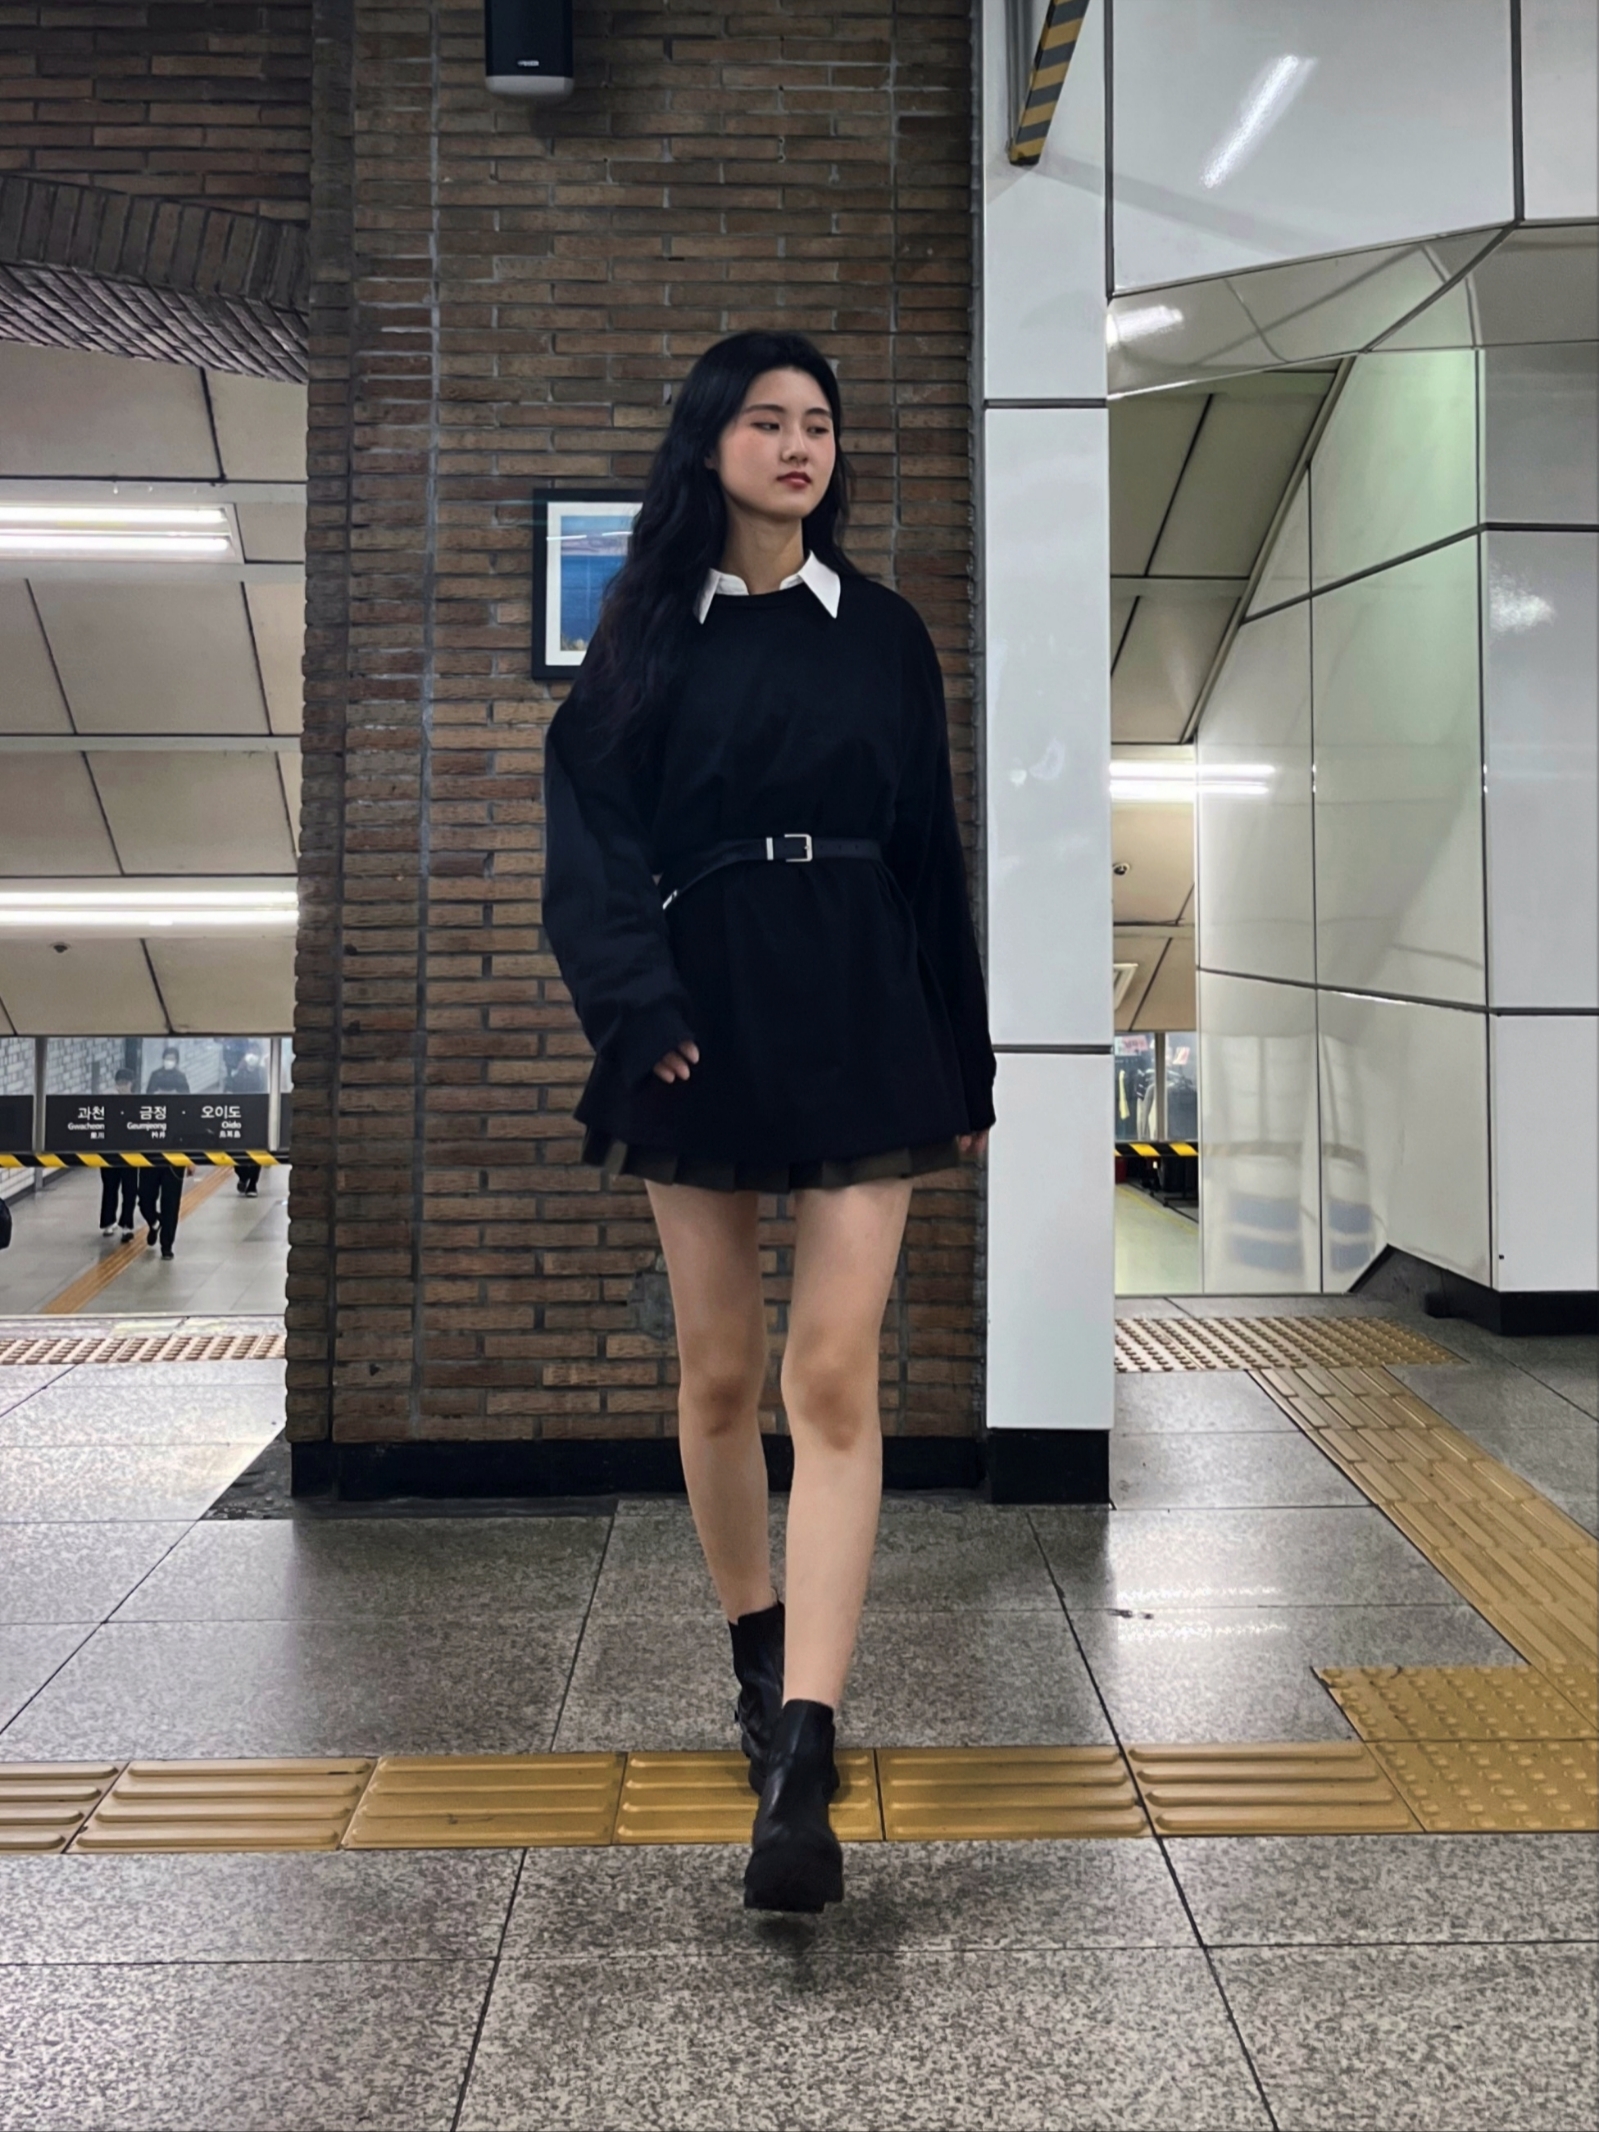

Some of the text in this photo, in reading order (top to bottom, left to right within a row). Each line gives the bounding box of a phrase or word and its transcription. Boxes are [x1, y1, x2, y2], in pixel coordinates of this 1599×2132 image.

[77, 1105, 242, 1121] 과천 금정 오이도
[221, 1120, 242, 1130] Oido
